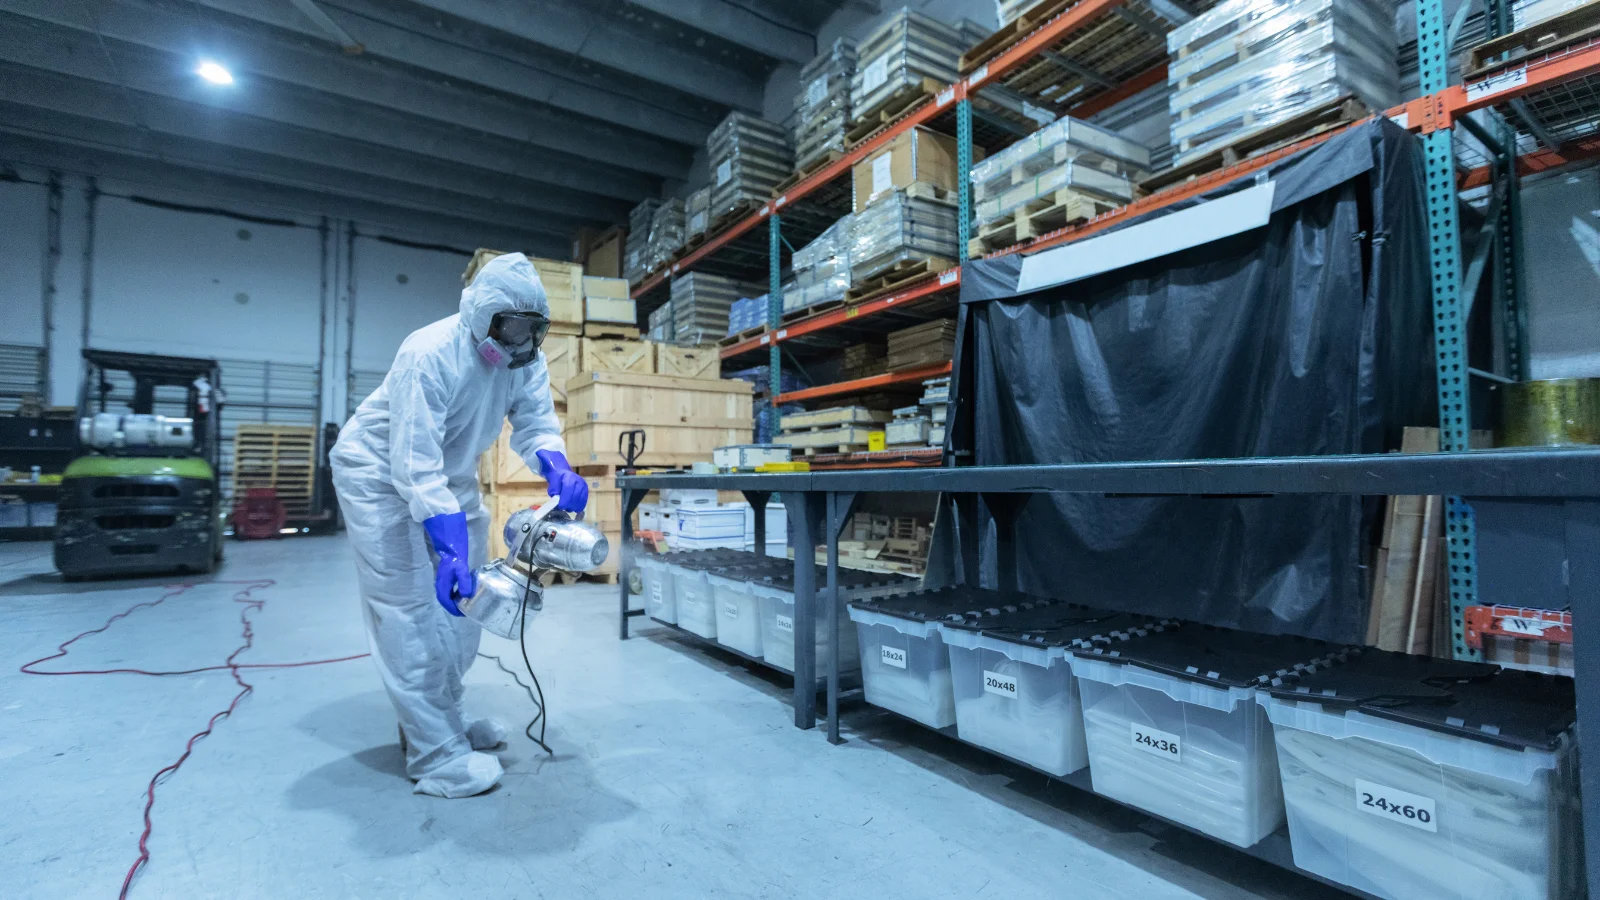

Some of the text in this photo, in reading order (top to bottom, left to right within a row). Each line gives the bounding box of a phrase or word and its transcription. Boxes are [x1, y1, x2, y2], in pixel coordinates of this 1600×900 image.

[882, 650, 903, 662] 18x24
[986, 677, 1015, 692] 20x48
[1135, 732, 1178, 754] 24x36
[1362, 792, 1431, 823] 24x60
